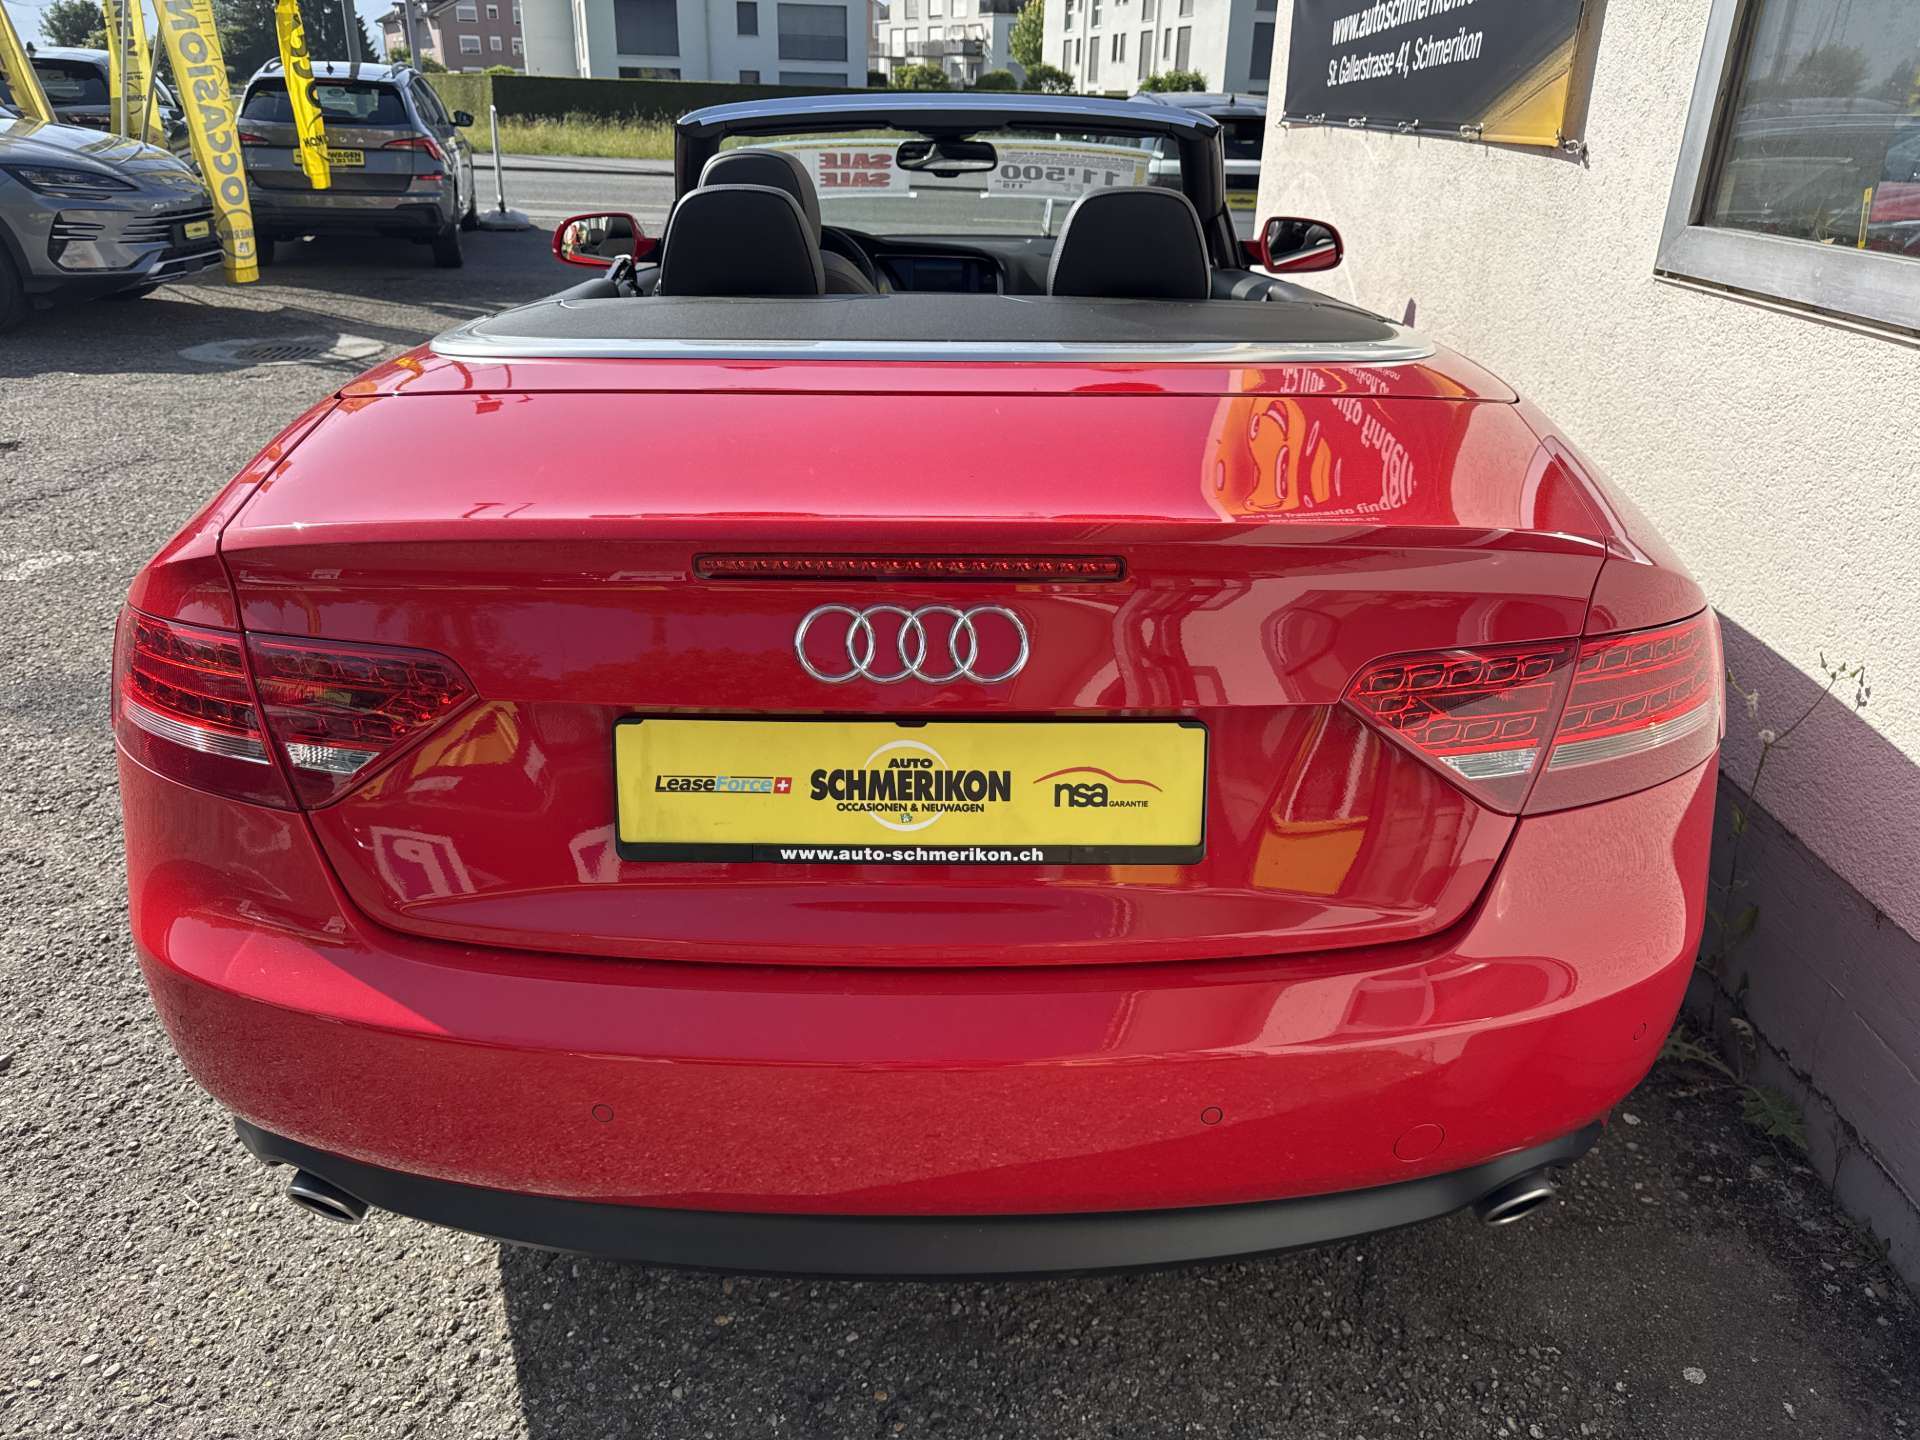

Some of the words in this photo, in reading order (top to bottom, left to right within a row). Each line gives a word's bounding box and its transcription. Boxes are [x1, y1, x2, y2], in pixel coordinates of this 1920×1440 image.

[1332, 0, 1478, 46] www.autoschmeriko.
[1339, 52, 1394, 85] Gallerstrasse
[1413, 26, 1483, 71] Schmerikon
[887, 758, 933, 769] AUTO
[655, 775, 773, 793] LeaseForce
[810, 769, 1011, 801] SCHMERIKON
[1054, 783, 1108, 808] nsa
[1109, 800, 1149, 808] GARANTIE
[836, 803, 908, 813] OCCASIONEN
[910, 803, 918, 812] &
[921, 803, 985, 813] NEUWAGEN
[779, 847, 1045, 863] www.auto-schmerikon.ch
